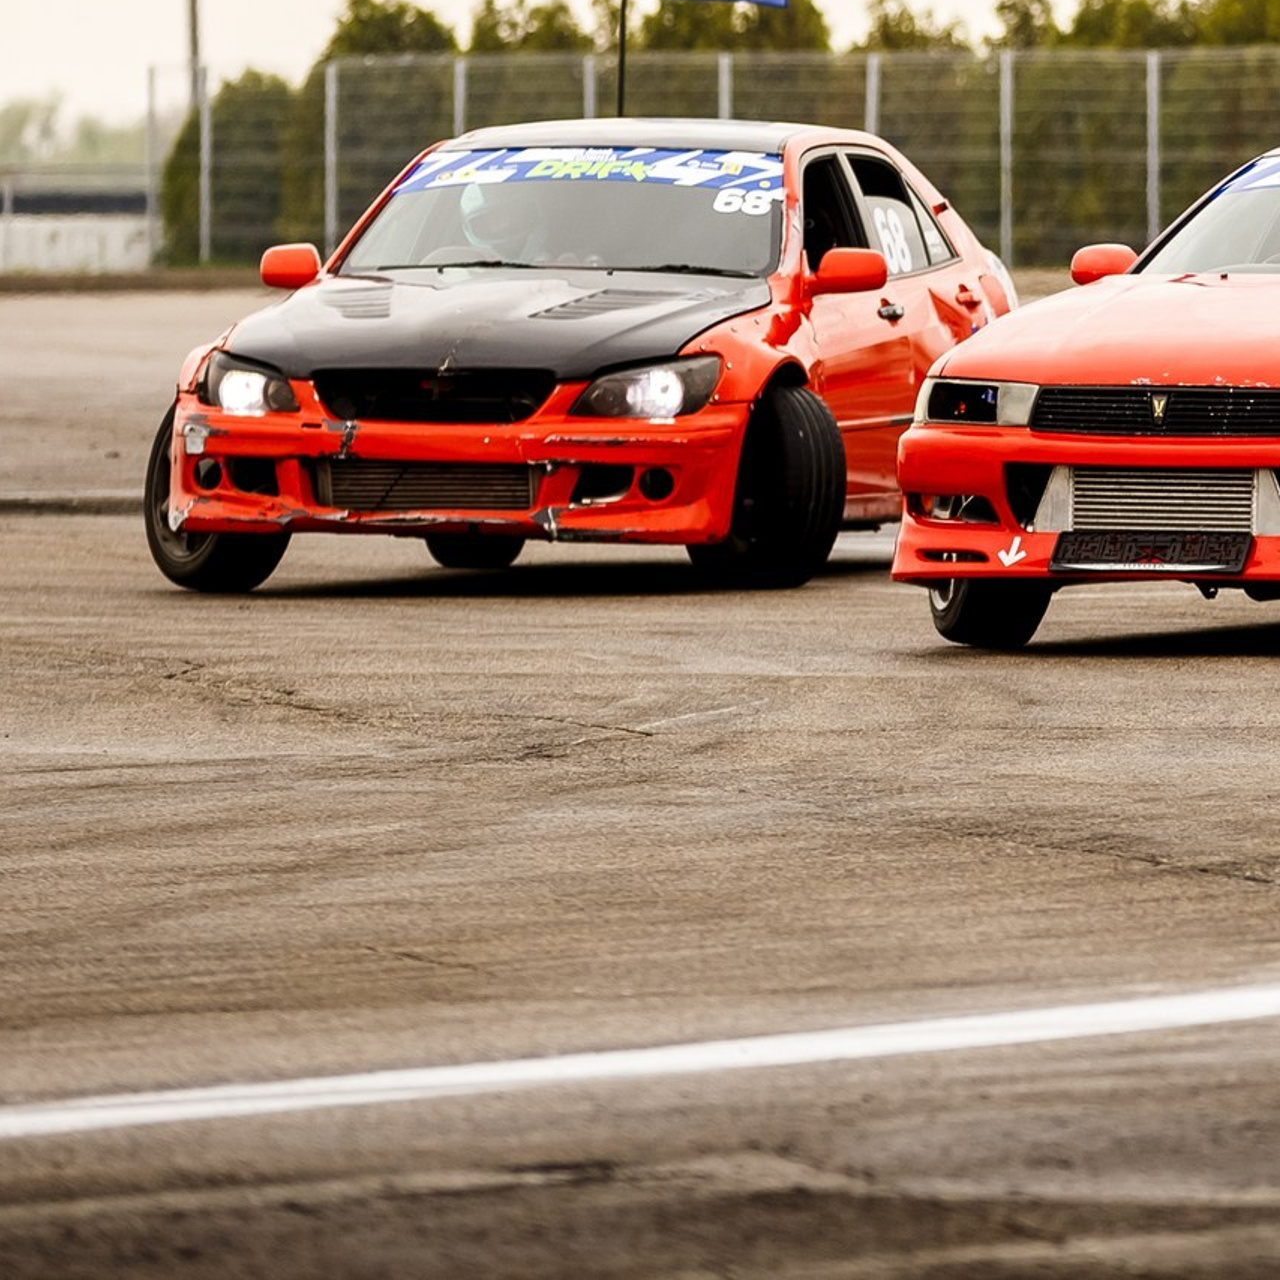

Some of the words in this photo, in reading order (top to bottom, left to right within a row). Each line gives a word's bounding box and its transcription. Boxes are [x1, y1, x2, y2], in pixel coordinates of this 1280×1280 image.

[524, 159, 655, 182] DRIFT
[713, 188, 772, 215] 68
[873, 207, 913, 274] 68
